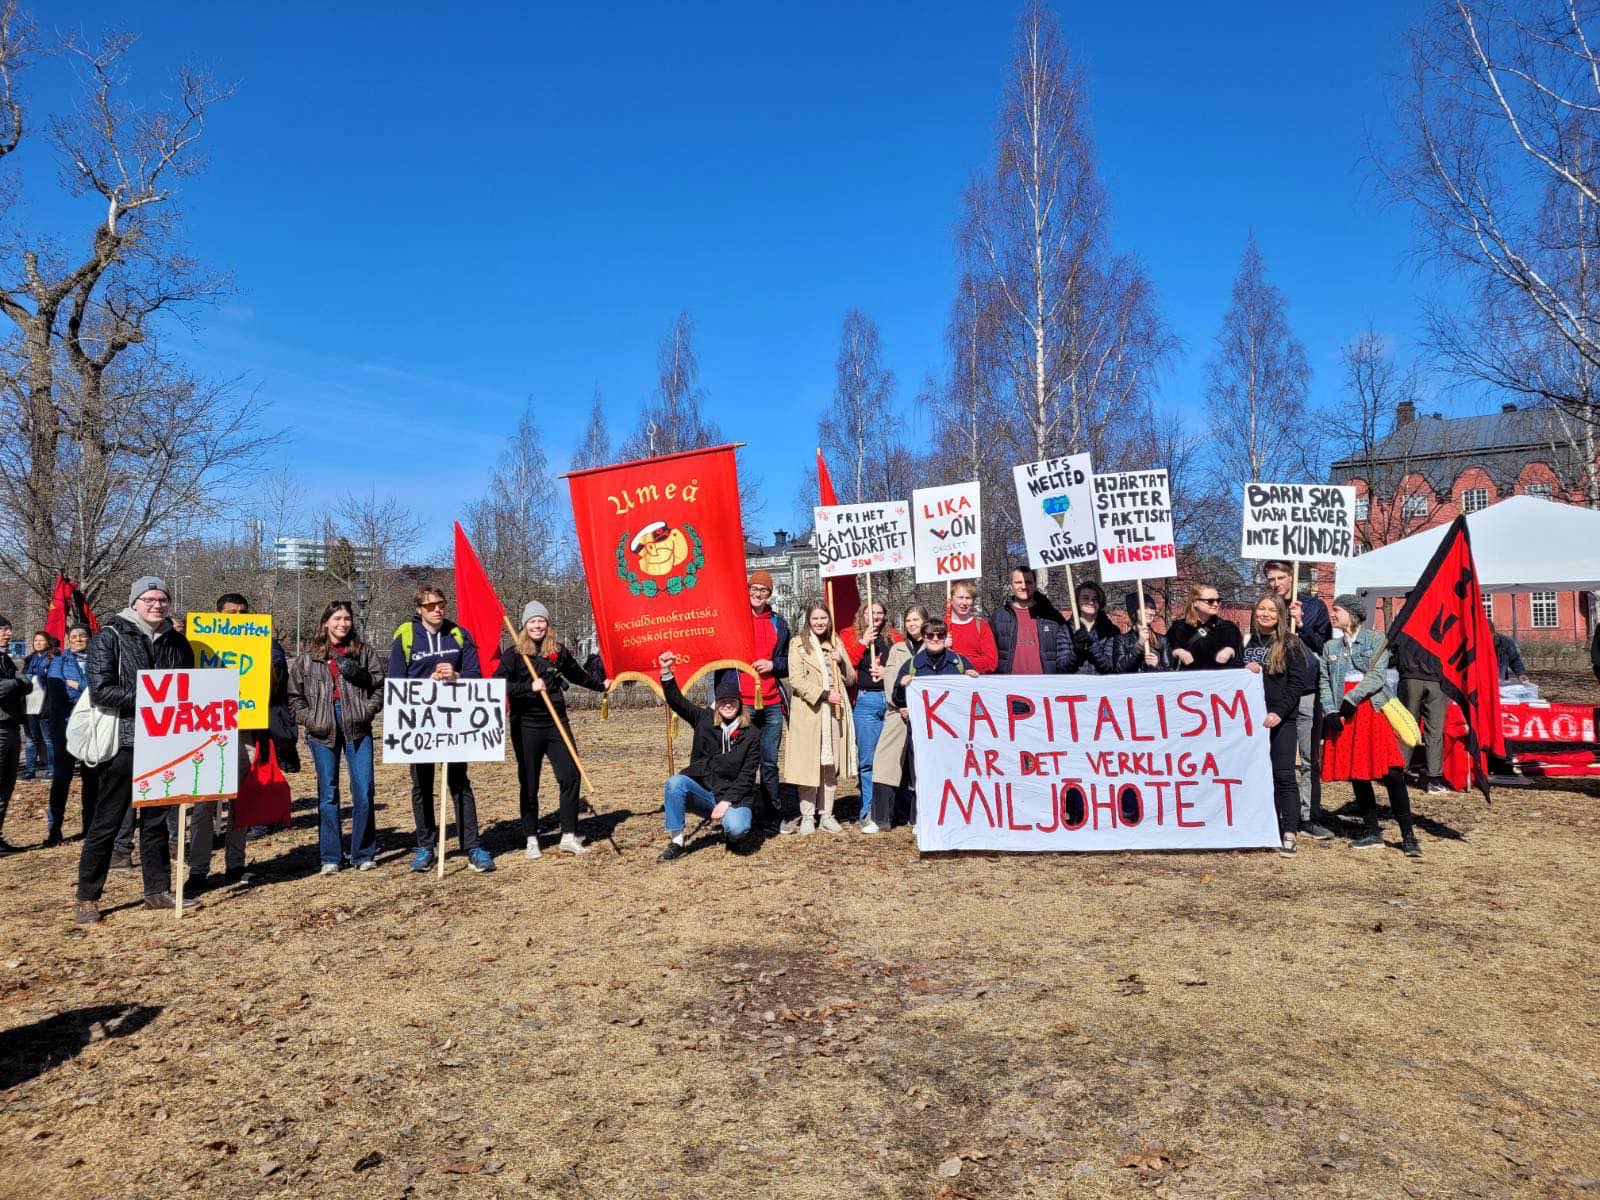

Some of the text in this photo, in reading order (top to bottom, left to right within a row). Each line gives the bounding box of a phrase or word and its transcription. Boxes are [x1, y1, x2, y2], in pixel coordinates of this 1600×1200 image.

[1027, 463, 1039, 477] IF
[1027, 469, 1085, 498] MELTED
[1094, 473, 1166, 494] HJÄRTAT
[608, 479, 700, 515] Umeå
[924, 496, 972, 518] LIKA
[1097, 490, 1163, 510] SITTER
[1247, 484, 1346, 508] BARN SKA
[836, 510, 884, 524] FRIHET
[1099, 509, 1170, 528] FAKTISKT
[1251, 507, 1288, 522] VARA
[1114, 526, 1156, 544] TILL
[1246, 524, 1352, 558] INTE KUNDER
[819, 532, 908, 565] SOLIDARITET
[1039, 541, 1098, 565] RUINED
[1102, 544, 1174, 564] VÄNSTER
[851, 558, 872, 568] SSU
[936, 551, 976, 576] KÖN
[652, 653, 690, 668] 180
[142, 672, 190, 704] VI
[387, 680, 500, 706] NEJ TILL
[140, 699, 238, 737] VÄXER
[922, 689, 1253, 743] KAPITALISM
[964, 744, 1220, 778] ÄR DET VERKLIGA
[938, 778, 1242, 832] MILJÖHOTET
